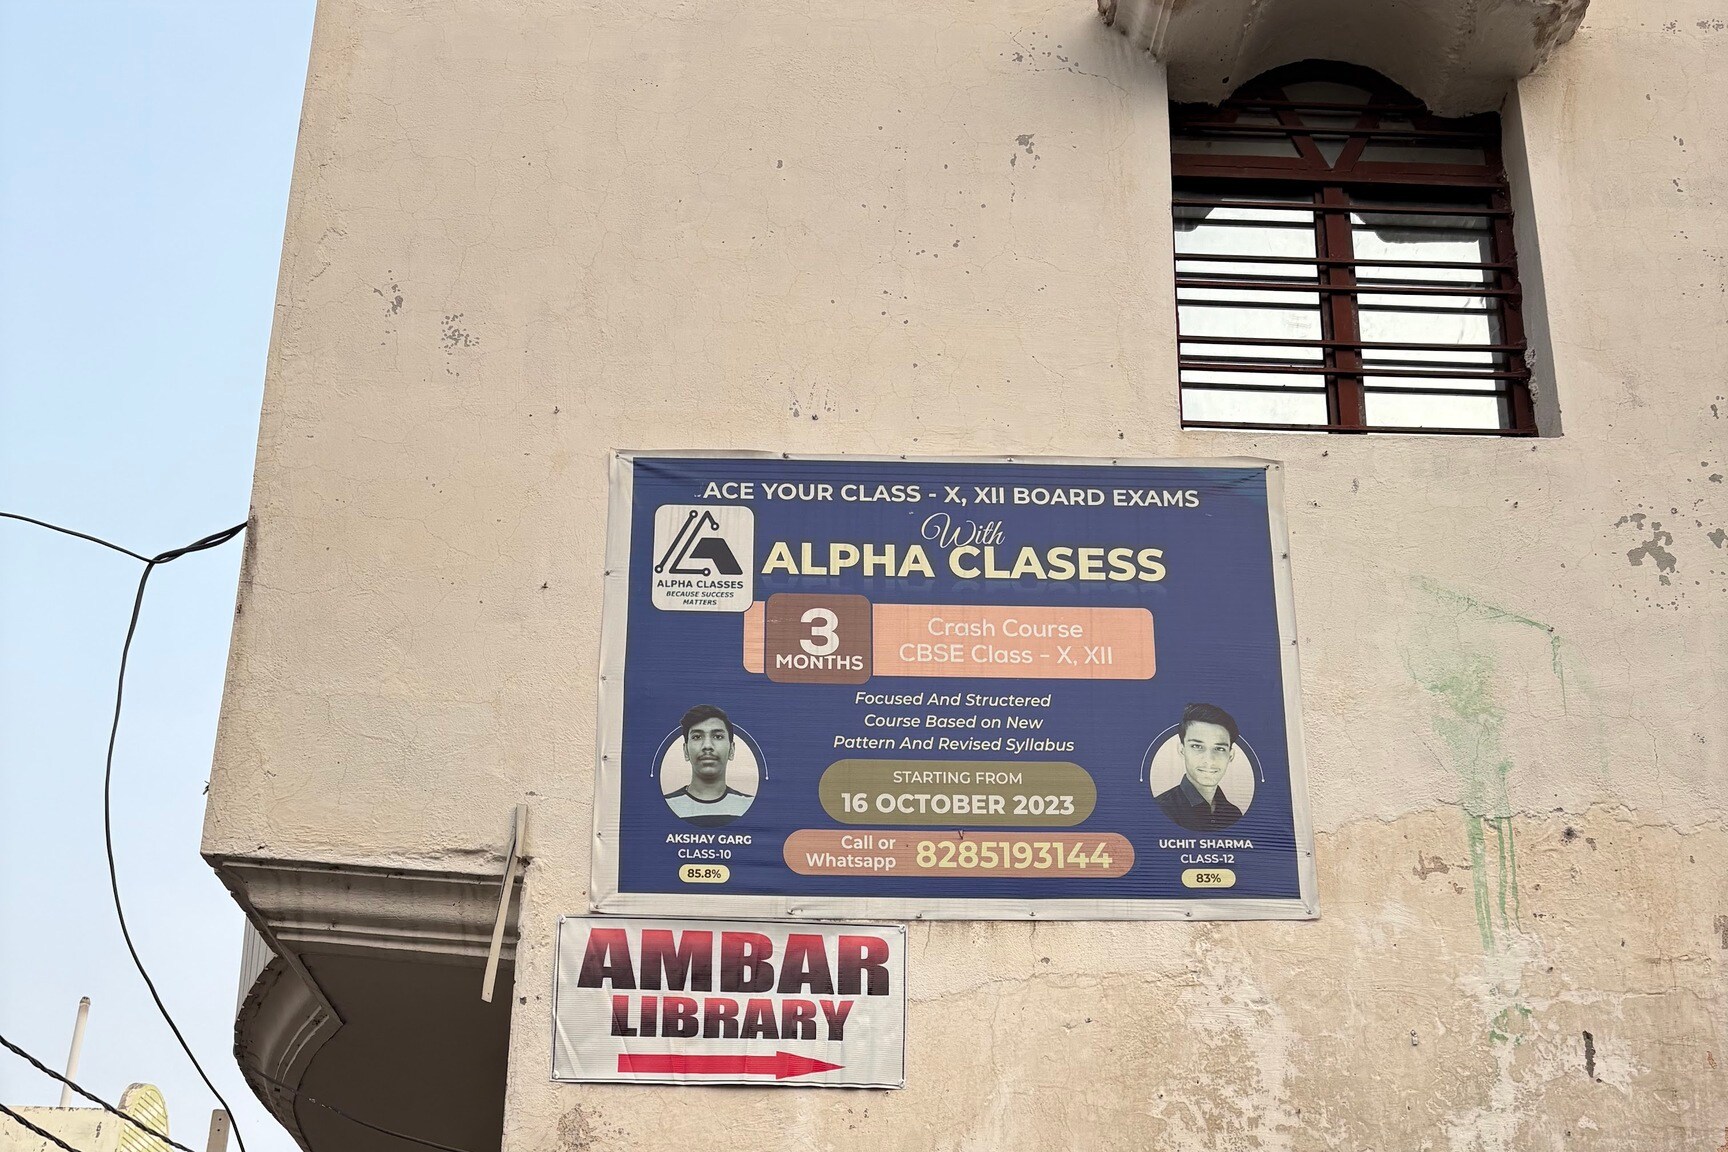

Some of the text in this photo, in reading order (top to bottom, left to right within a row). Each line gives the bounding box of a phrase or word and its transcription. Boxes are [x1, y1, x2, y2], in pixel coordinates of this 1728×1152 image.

[703, 481, 754, 500] ACE
[761, 483, 834, 501] YOUR
[840, 484, 921, 502] CLASS
[944, 486, 967, 507] X,
[974, 486, 1005, 504] XII
[1013, 487, 1105, 506] BOARD
[1113, 489, 1200, 508] EXAMS
[921, 512, 1005, 548] With
[761, 541, 1166, 582] ALPHA CLASESS
[657, 580, 744, 589] ALPHA CLASSES
[800, 607, 840, 656] 3
[928, 617, 1083, 638] Crash Course
[776, 654, 864, 671] MONTHS
[899, 643, 964, 663] CBSE
[971, 644, 1033, 663] Class
[1056, 645, 1078, 666] X,
[1084, 646, 1113, 665] XII
[855, 691, 1051, 708] Focused And Structered
[864, 714, 1044, 729] Course Based on New
[833, 735, 1075, 754] Pattern And Revised Syllabus
[893, 771, 1023, 785] STARTING FROM
[841, 793, 1075, 815] 16 OCTOBER 2023
[665, 833, 752, 845] AKSHAY GARG
[841, 835, 896, 850] Call or
[1159, 839, 1254, 849] UCHIT SHARMA
[678, 848, 731, 860] CLASS-10
[806, 853, 896, 871] Whatsapp
[916, 840, 1113, 869] 8285193144
[1180, 854, 1235, 864] CLASS-12
[687, 868, 721, 879] 85.8%
[1196, 873, 1221, 883] 83%
[577, 927, 890, 996] AMBAR
[610, 995, 854, 1041] LIBRARY
